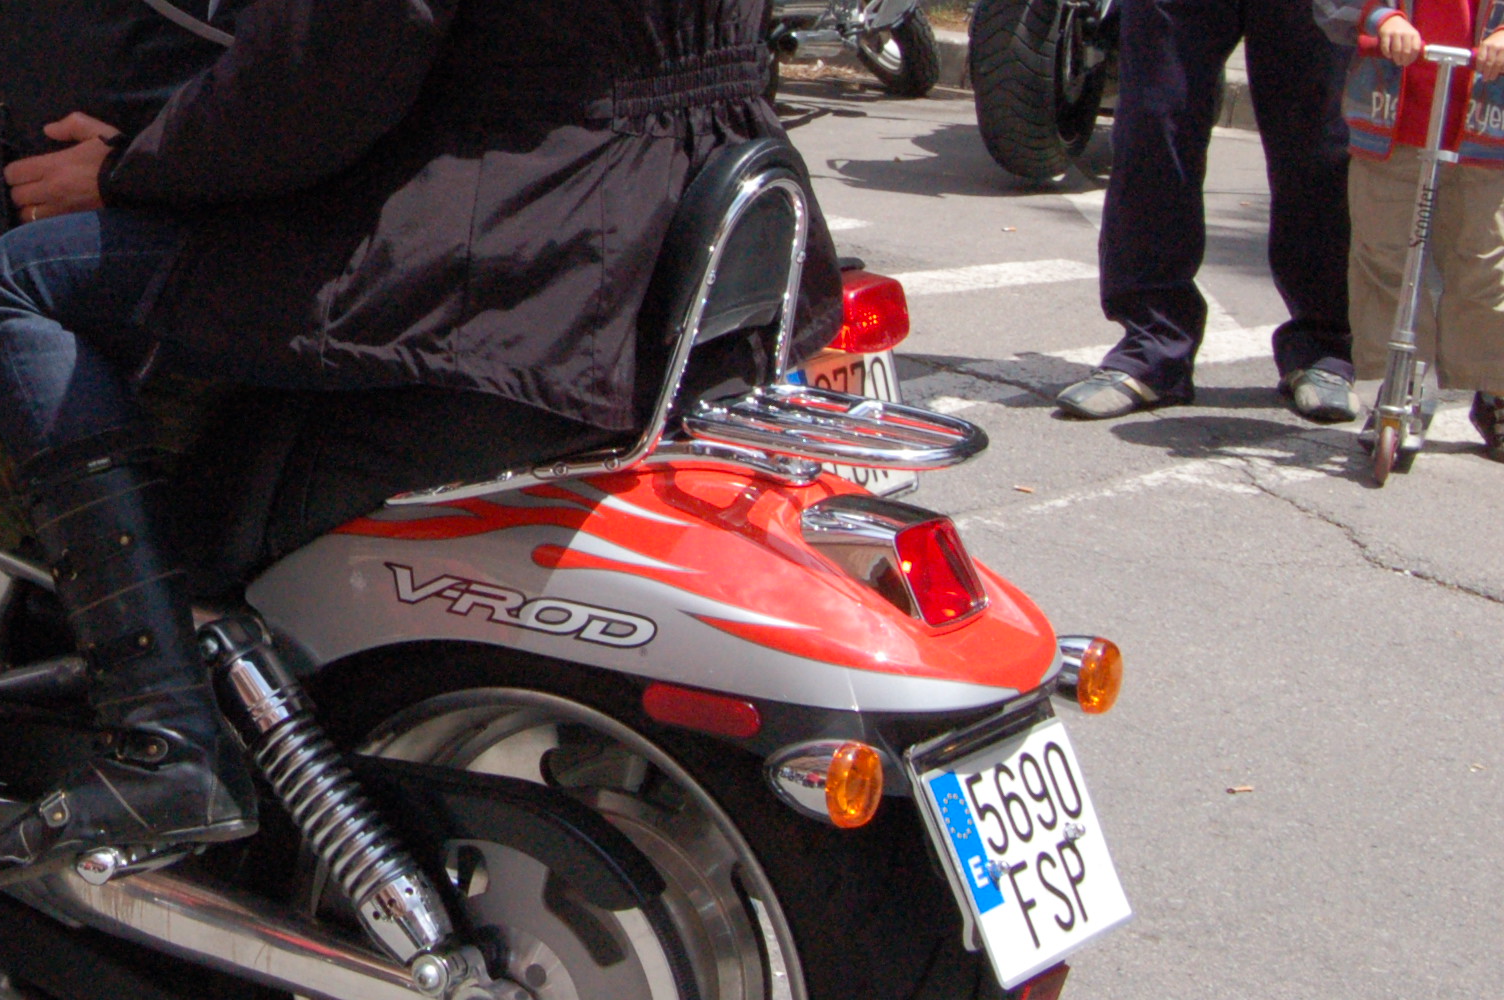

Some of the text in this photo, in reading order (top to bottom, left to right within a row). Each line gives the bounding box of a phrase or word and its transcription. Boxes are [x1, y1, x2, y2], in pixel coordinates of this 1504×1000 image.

[1408, 185, 1437, 248] Scooter
[384, 562, 657, 648] V-ROD
[965, 741, 1082, 855] 5690
[967, 855, 990, 888] E
[1008, 839, 1088, 949] FSP
